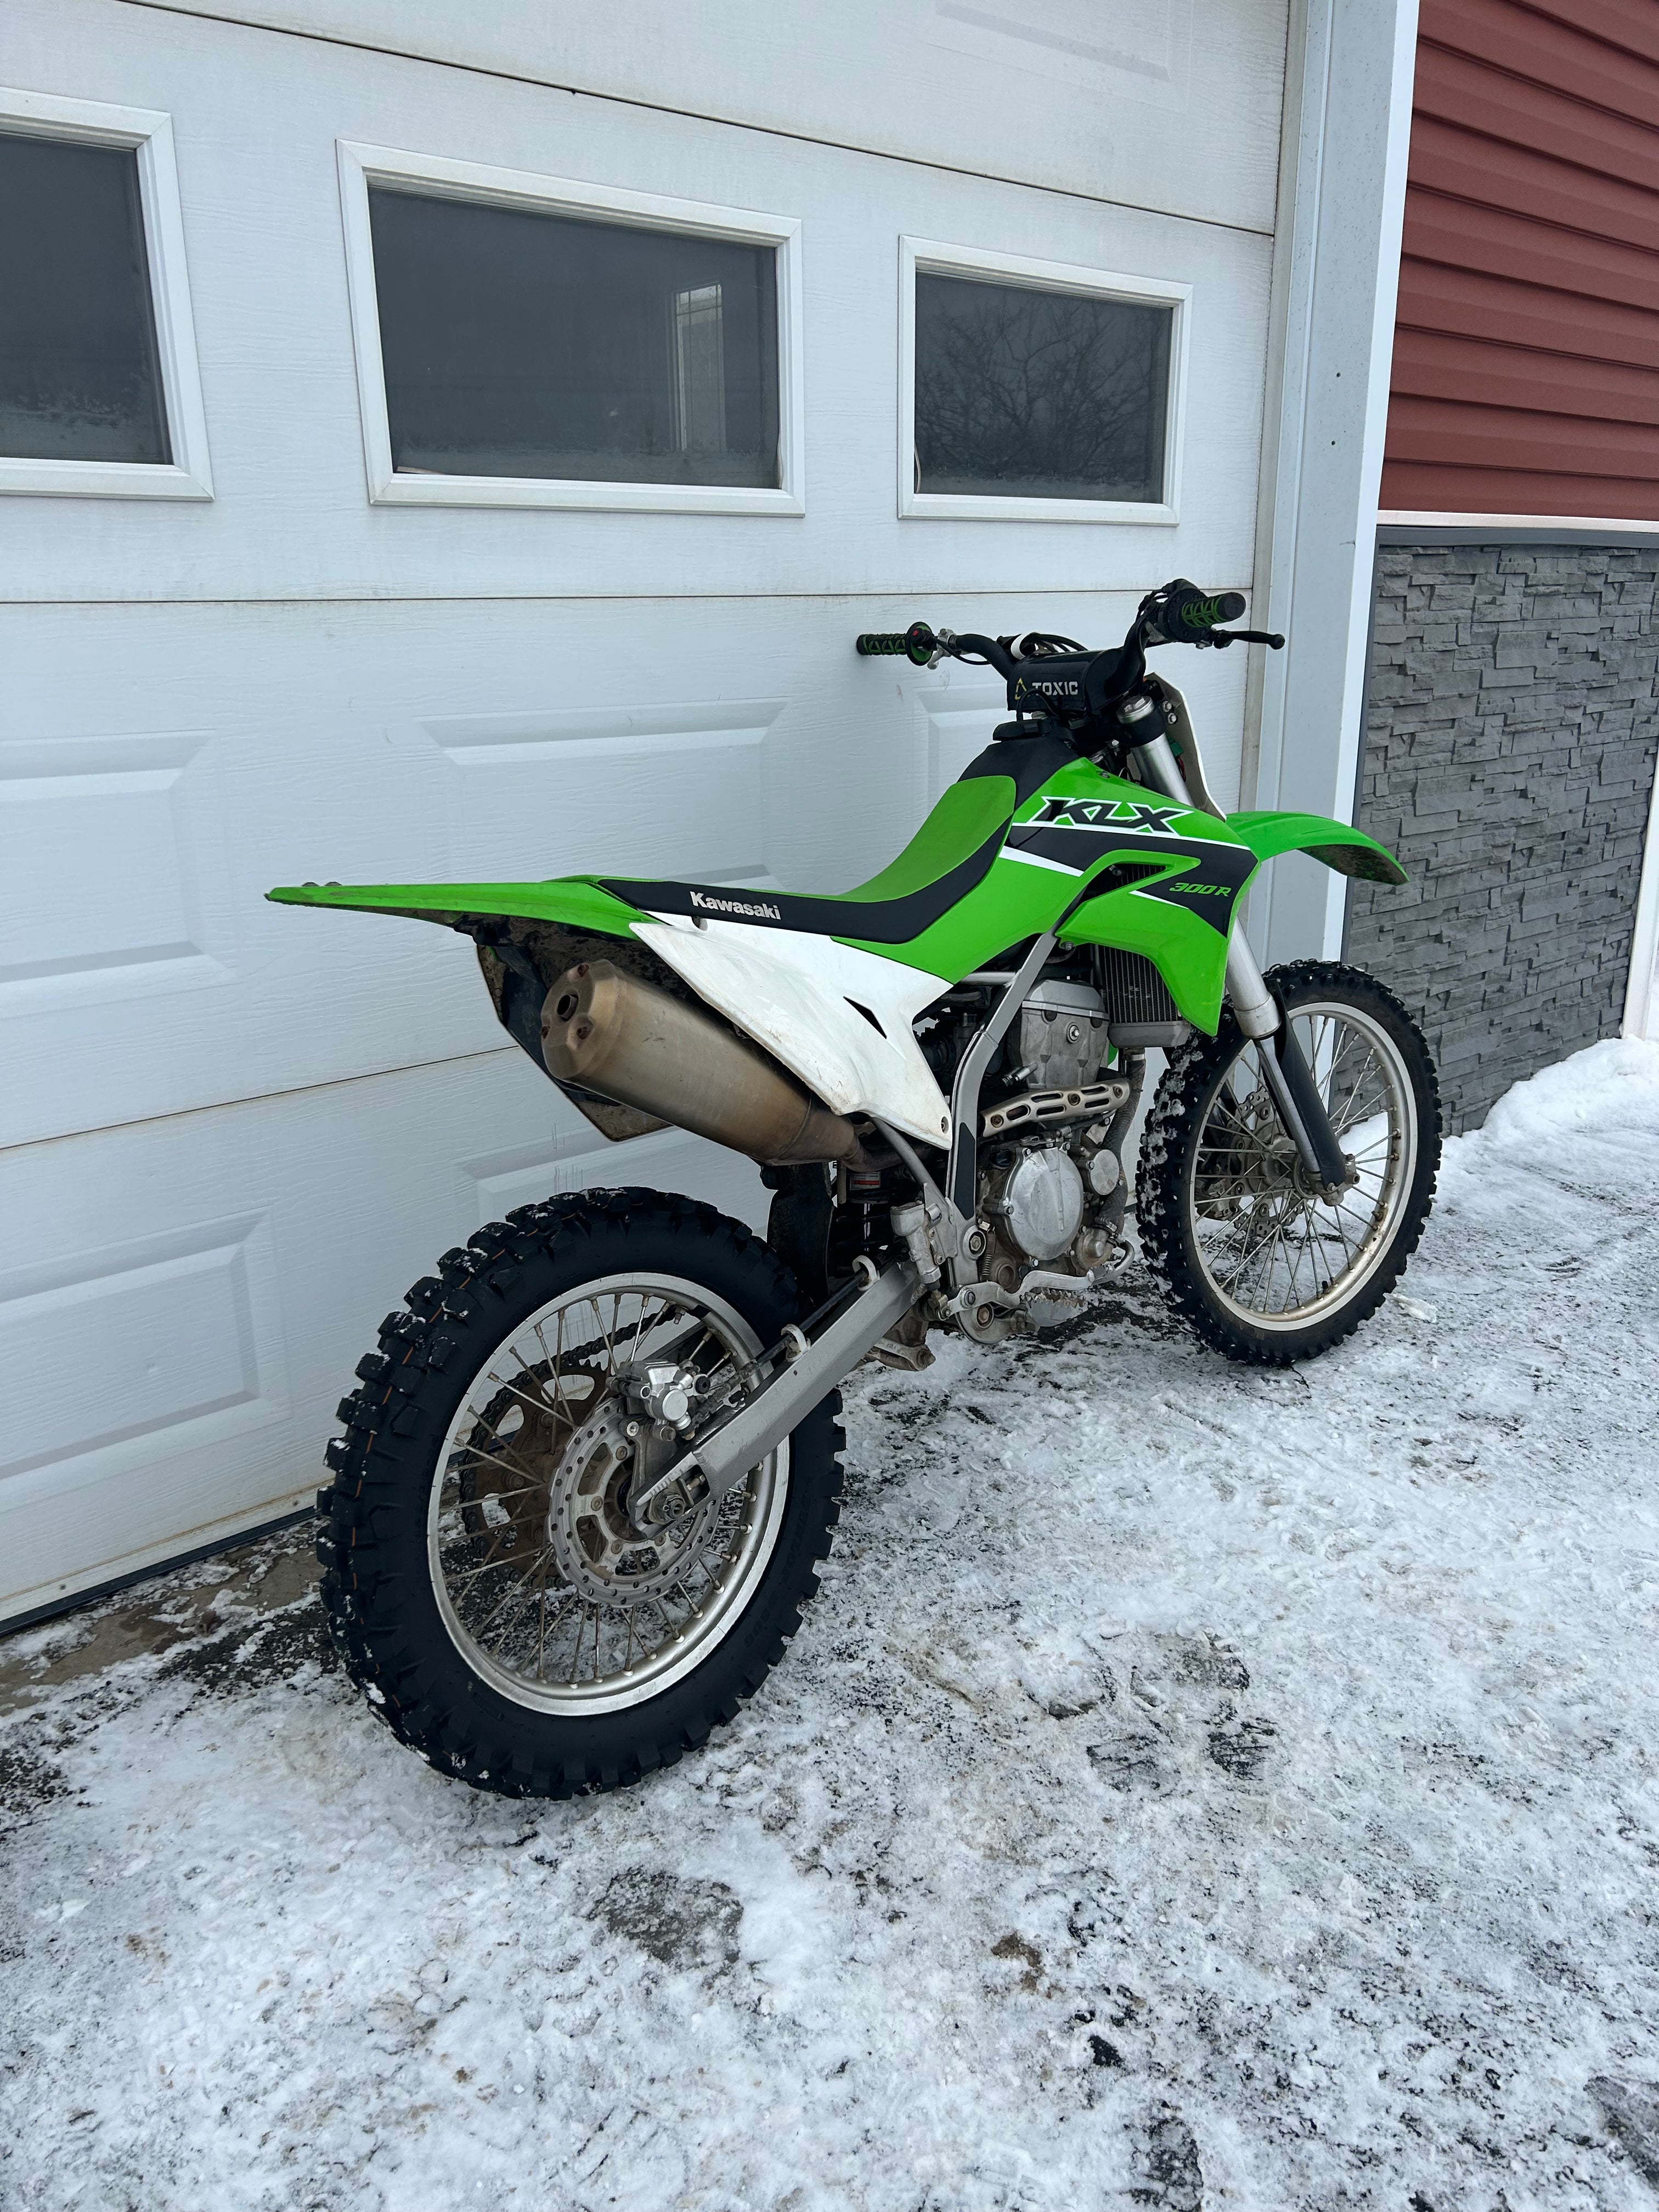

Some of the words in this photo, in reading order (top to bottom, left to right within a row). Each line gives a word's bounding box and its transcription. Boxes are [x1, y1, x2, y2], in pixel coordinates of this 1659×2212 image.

[1032, 681, 1078, 696] TOXIC
[1028, 796, 1194, 835] KLX
[1169, 882, 1231, 897] 300R
[690, 891, 781, 920] Kawasaki
